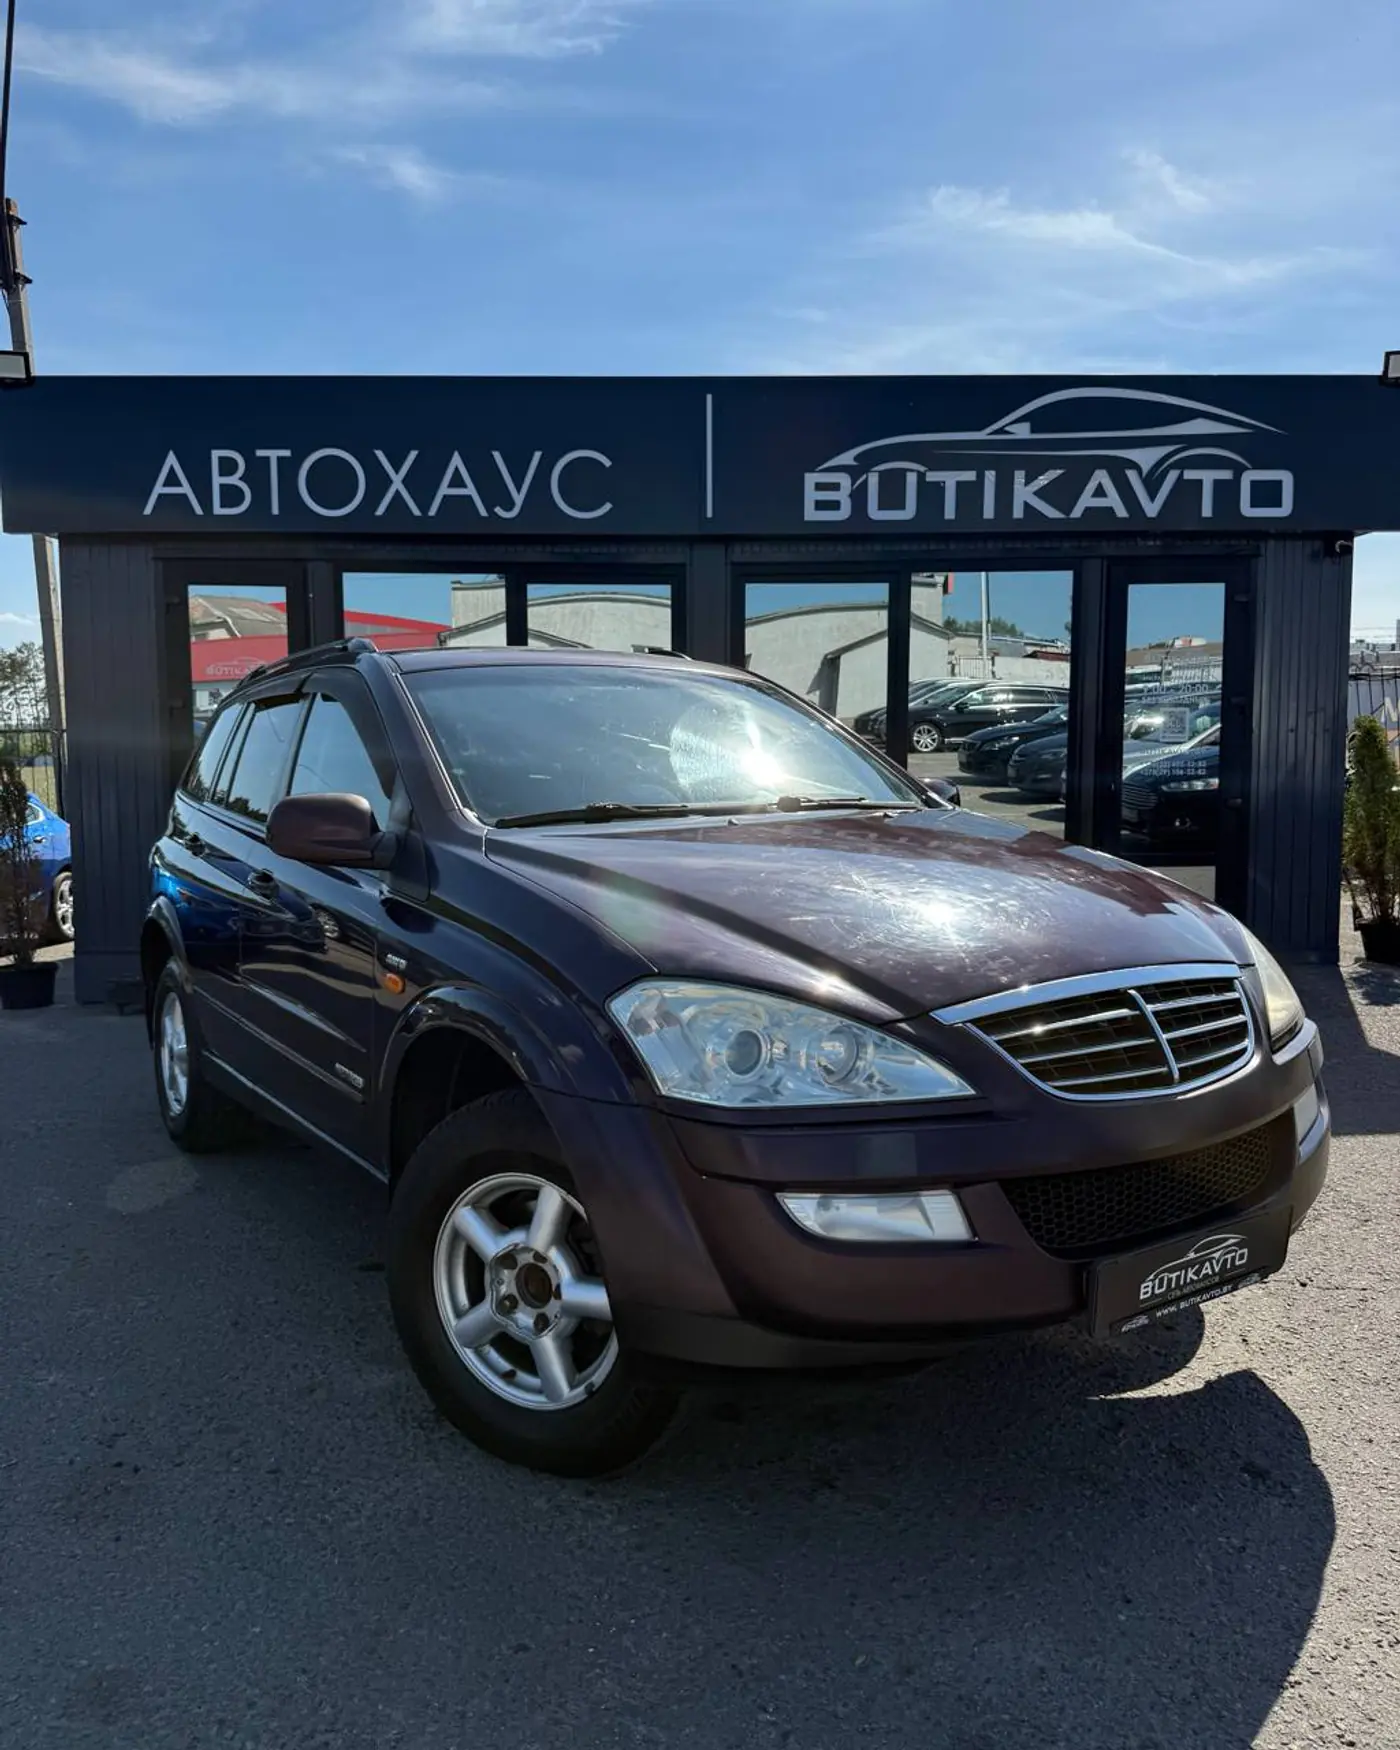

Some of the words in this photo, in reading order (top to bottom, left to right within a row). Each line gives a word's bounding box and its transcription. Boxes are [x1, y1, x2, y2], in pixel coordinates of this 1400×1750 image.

[143, 447, 614, 519] АВТОХАУС
[804, 469, 1294, 521] BUTIKAVTO
[1139, 1248, 1249, 1300] BUTIKAVTO
